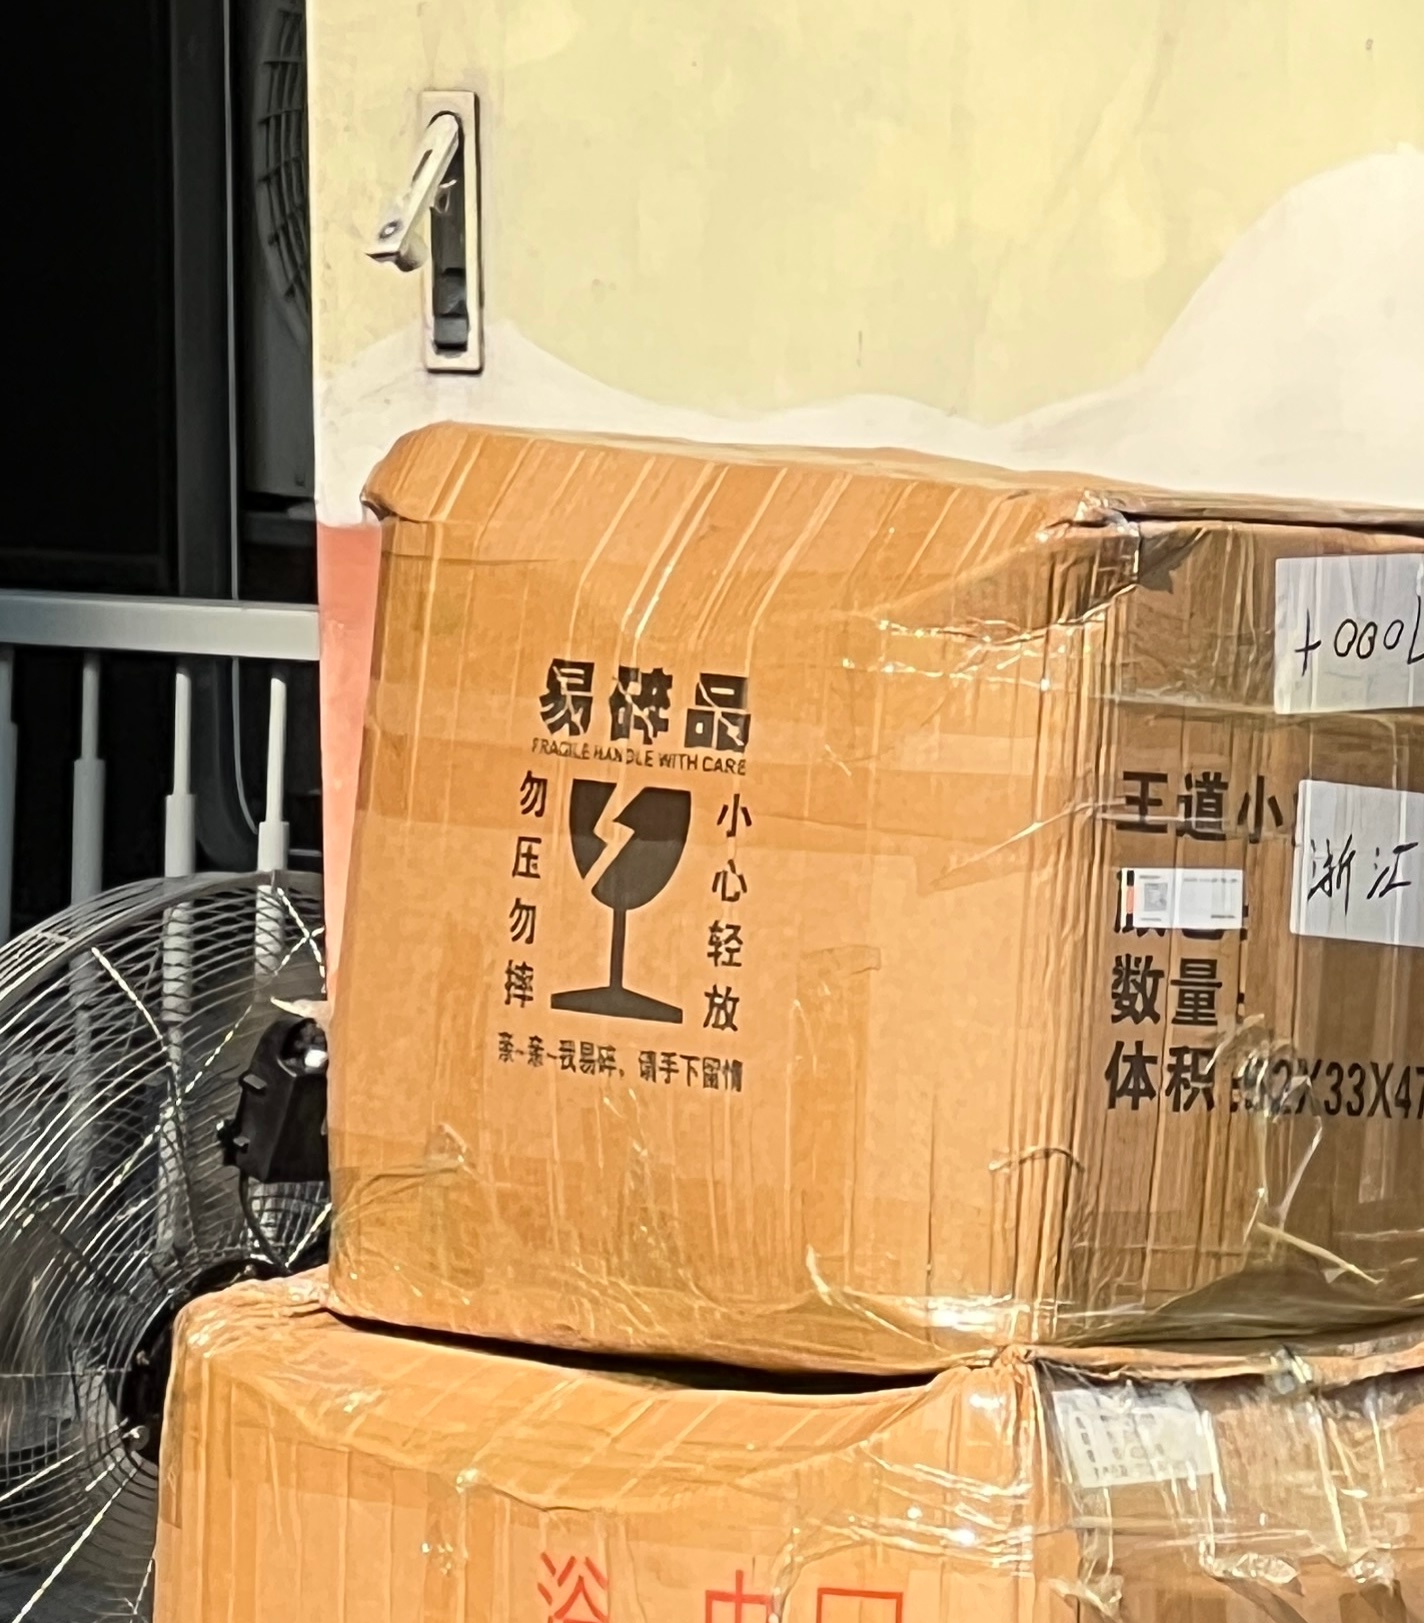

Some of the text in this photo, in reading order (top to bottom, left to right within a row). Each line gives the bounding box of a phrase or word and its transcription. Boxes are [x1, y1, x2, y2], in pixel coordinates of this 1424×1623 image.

[539, 658, 751, 752] 易碎品
[531, 737, 747, 776] FRAGILE HANDLE WITH CARE
[1116, 771, 1299, 848] 王道小
[504, 770, 548, 1008] 勿压勿摔
[703, 793, 753, 1032] 小心轻放
